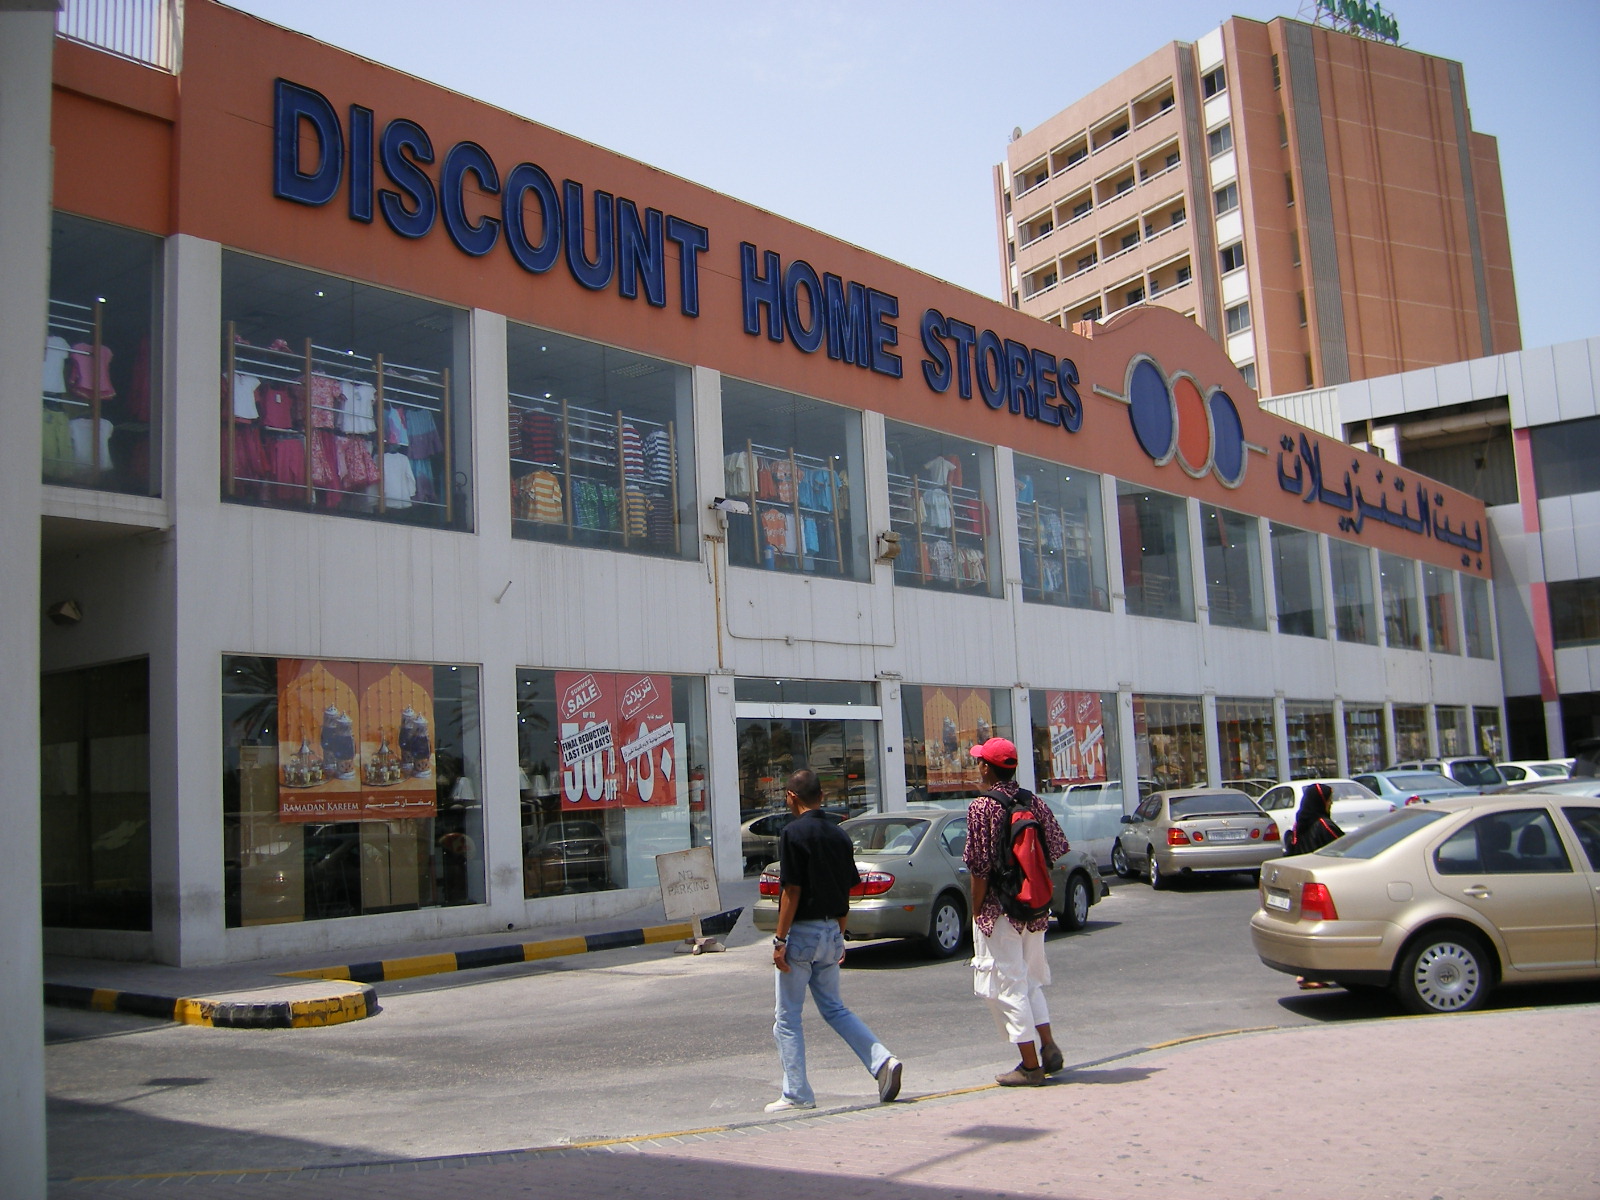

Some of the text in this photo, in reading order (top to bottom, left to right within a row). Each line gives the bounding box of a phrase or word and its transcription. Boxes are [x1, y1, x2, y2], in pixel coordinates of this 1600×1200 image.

[273, 77, 1084, 433] DISCOUNT HOME STORES
[1277, 432, 1483, 571] بيت التنزيلات
[570, 678, 592, 696] SUMMER
[567, 683, 598, 714] SALE
[562, 724, 610, 752] FINAL REDUCTION
[564, 747, 581, 762] LAST
[580, 741, 595, 755] FEW
[604, 779, 617, 801] OFF
[283, 802, 359, 813] RAMADAN KAREEM
[678, 870, 694, 880] NO
[668, 881, 709, 896] PARKING
